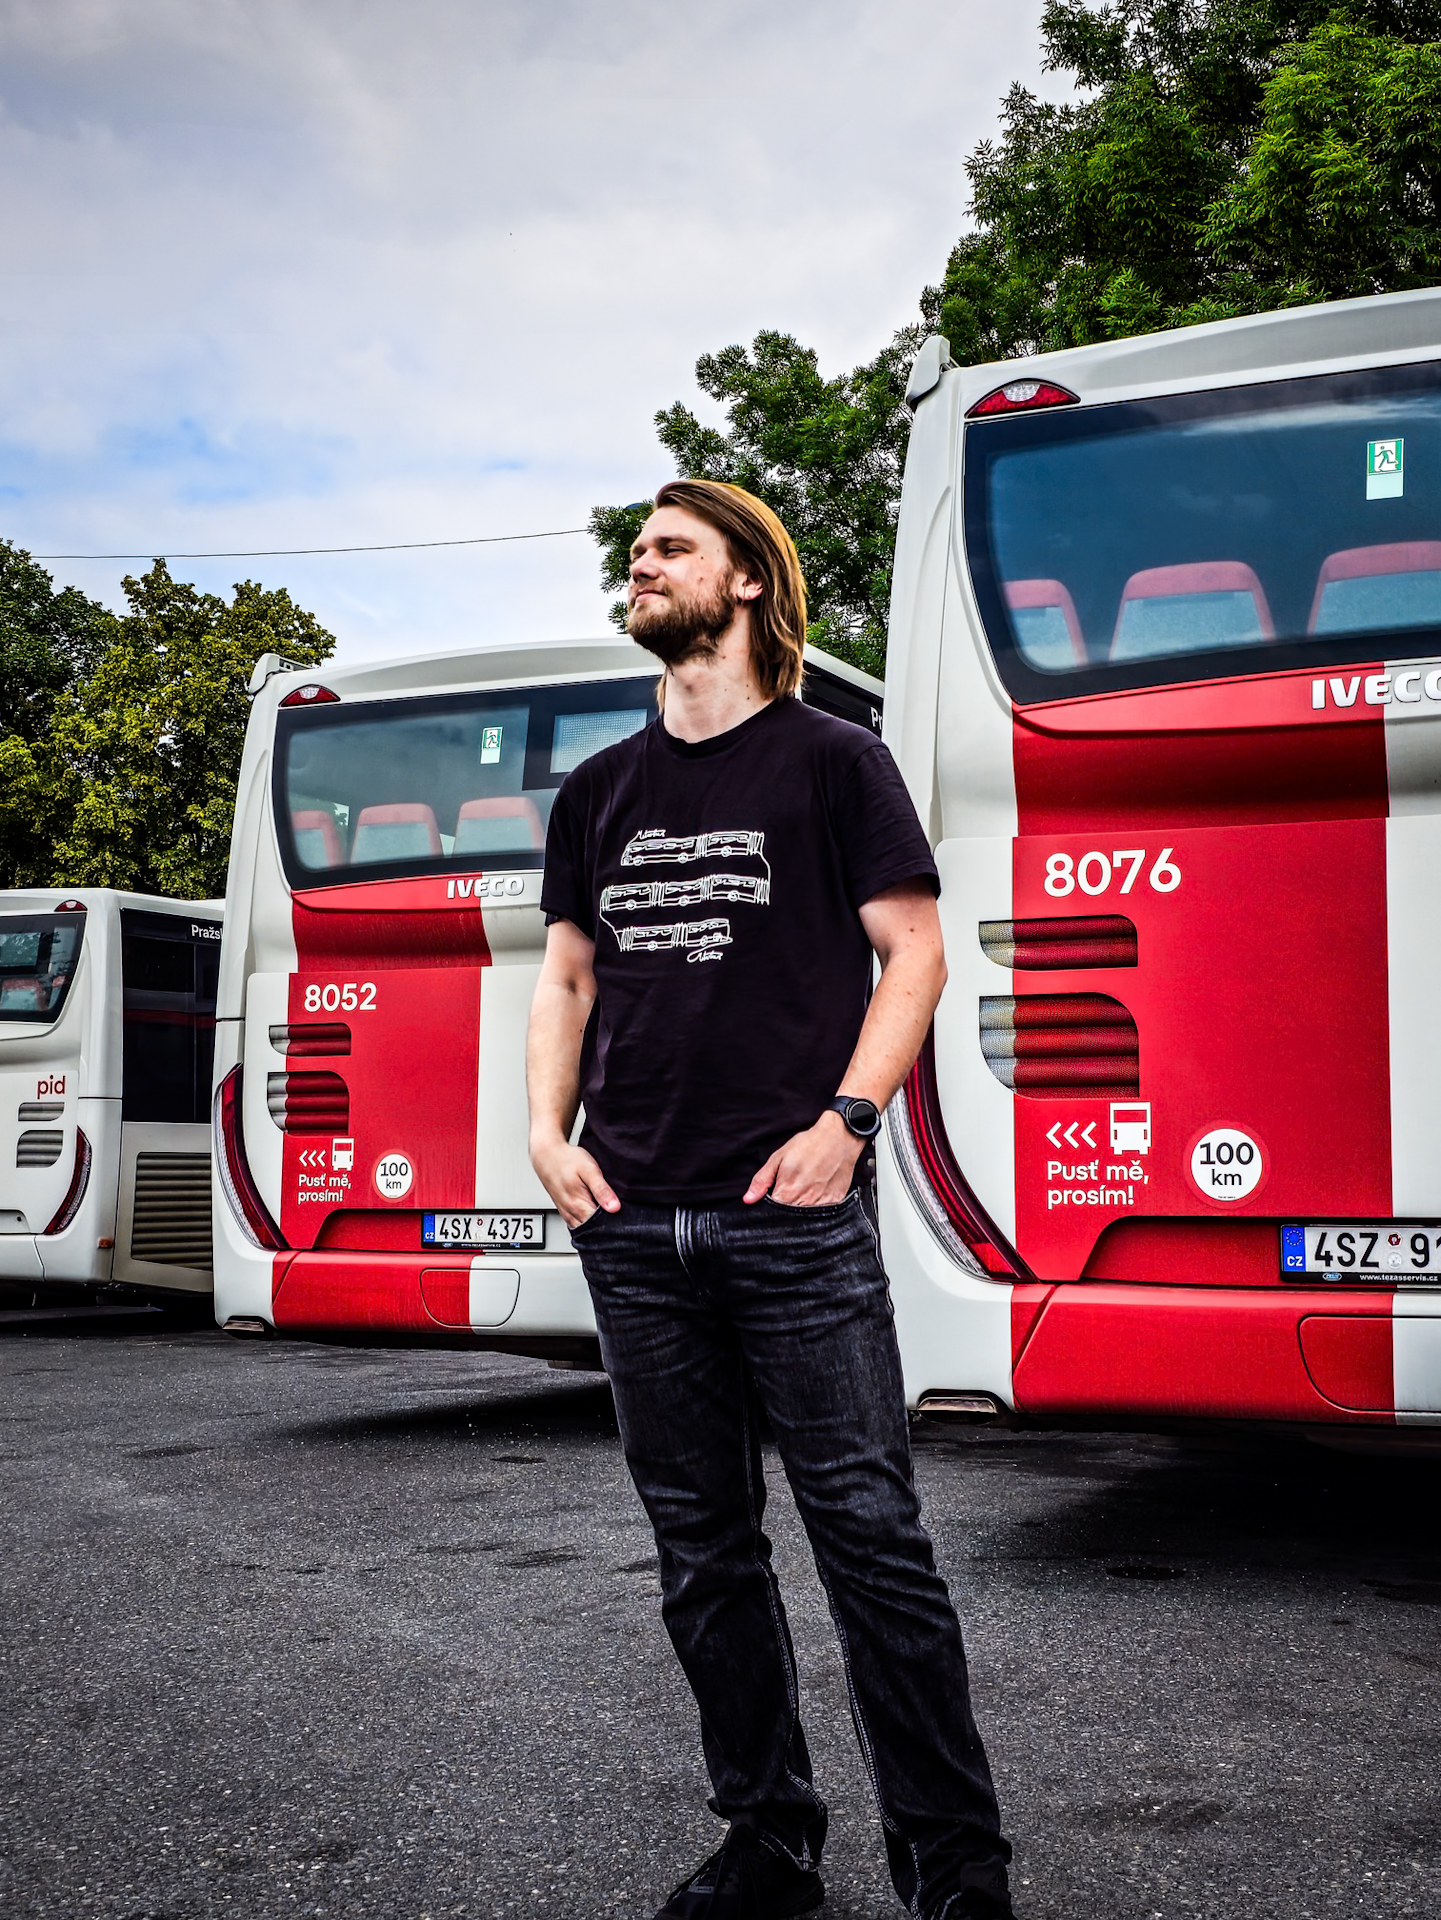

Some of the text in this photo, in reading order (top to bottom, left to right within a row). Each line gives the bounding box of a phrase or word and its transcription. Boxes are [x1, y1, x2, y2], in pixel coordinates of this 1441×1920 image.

[1312, 670, 1441, 709] IVECO
[1043, 847, 1182, 898] 8076
[447, 876, 525, 899] IVECO
[304, 982, 377, 1013] 8052
[37, 1074, 66, 1100] pid
[1199, 1141, 1255, 1166] 100
[380, 1162, 408, 1177] 100
[1046, 1159, 1149, 1185] Pusť mě,
[1211, 1168, 1242, 1187] km
[298, 1173, 352, 1190] Pusť mě,
[385, 1178, 402, 1189] km
[297, 1188, 343, 1205] prosím!
[1046, 1184, 1135, 1209] prosím!
[425, 1232, 434, 1240] CZ
[439, 1217, 533, 1240] 4SX 4375
[1286, 1255, 1304, 1267] CZ
[1314, 1231, 1441, 1268] 4SZ 9
